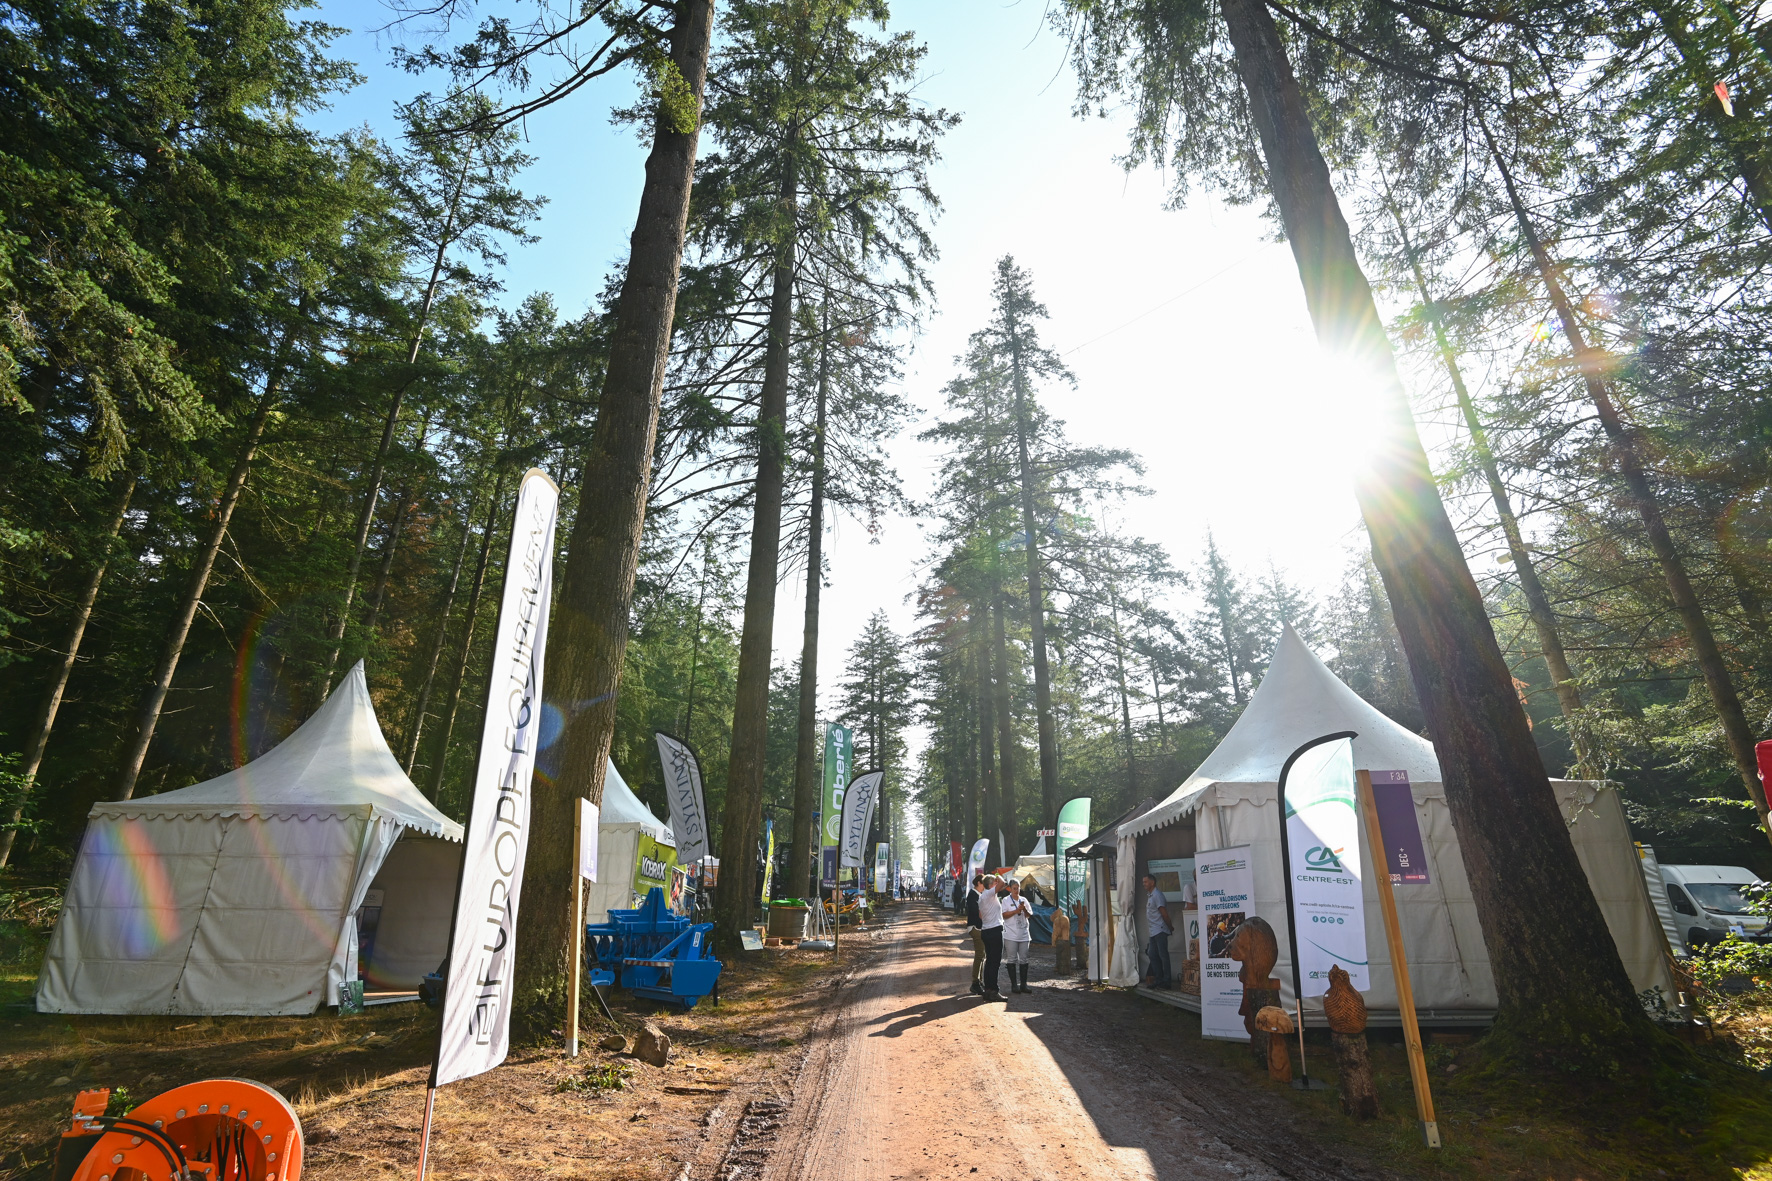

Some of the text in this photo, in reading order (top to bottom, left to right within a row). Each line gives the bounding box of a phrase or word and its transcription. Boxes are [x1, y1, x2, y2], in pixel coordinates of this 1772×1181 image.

[477, 495, 543, 986] EUROPE EQUIPEMENT
[832, 728, 845, 810] Oberlé
[1396, 771, 1405, 780] 34
[1399, 853, 1410, 867] DEC
[1297, 875, 1353, 885] CENTRE-EST
[1220, 894, 1248, 902] VALORISONS
[1211, 902, 1239, 910] PROTÉGEONS
[1214, 962, 1230, 970] FORÊTS
